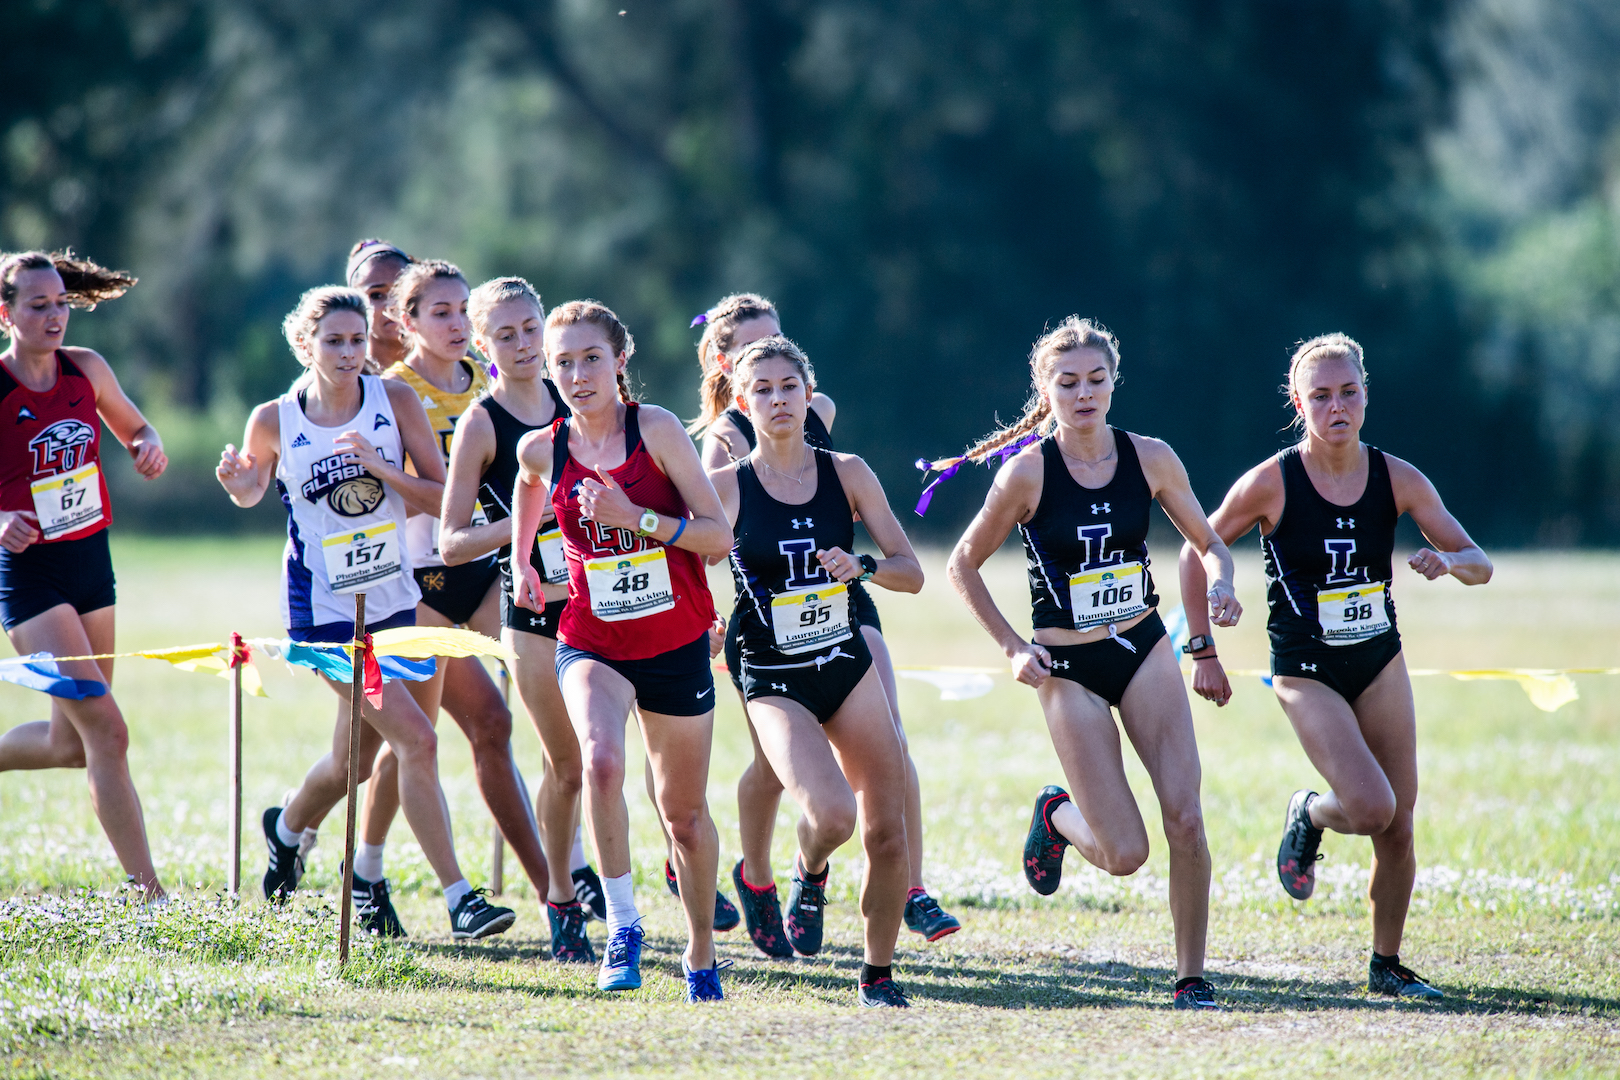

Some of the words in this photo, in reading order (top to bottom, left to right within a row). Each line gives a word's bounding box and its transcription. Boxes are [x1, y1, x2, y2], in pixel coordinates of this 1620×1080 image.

[61, 487, 87, 511] 67
[345, 542, 386, 568] 157
[1077, 523, 1125, 572] L
[335, 569, 370, 581] Phoebe
[373, 561, 395, 571] Moon
[552, 567, 569, 576] Gra
[778, 538, 831, 590] L
[1324, 539, 1371, 584] L
[612, 572, 649, 594] 48
[597, 599, 631, 609] Adelyn
[635, 590, 669, 603] Ackley
[1091, 584, 1133, 607] 106
[800, 604, 832, 627] 95
[1077, 610, 1115, 621] Hannah
[1117, 604, 1143, 614] Owens
[1343, 603, 1372, 622] 98
[786, 630, 820, 641] Lauren
